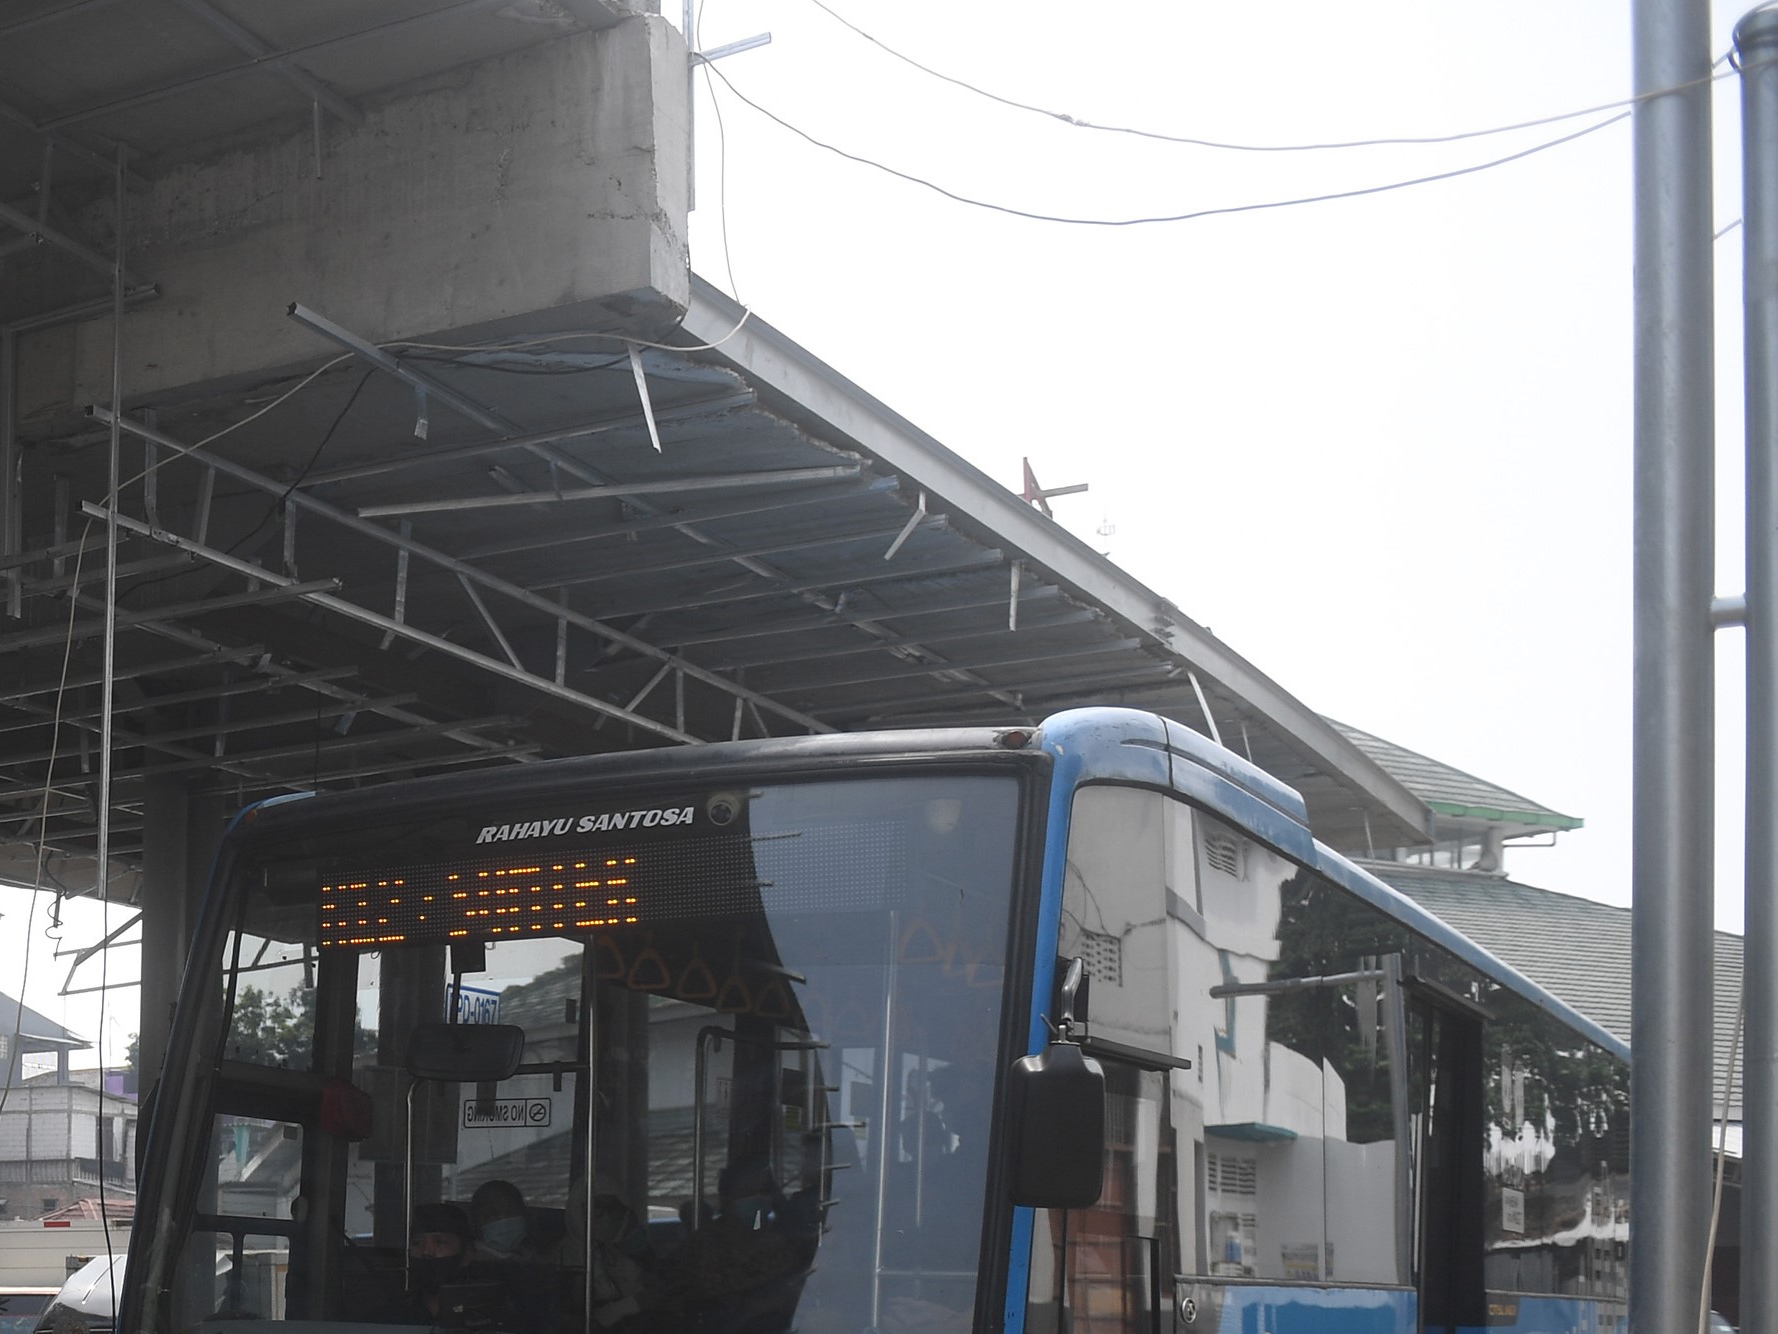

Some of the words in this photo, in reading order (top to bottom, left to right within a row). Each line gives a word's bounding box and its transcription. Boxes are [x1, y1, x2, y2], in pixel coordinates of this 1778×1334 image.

[476, 818, 573, 844] RAHAYU
[576, 807, 695, 833] SANTOSA
[449, 994, 498, 1024] PD-0167
